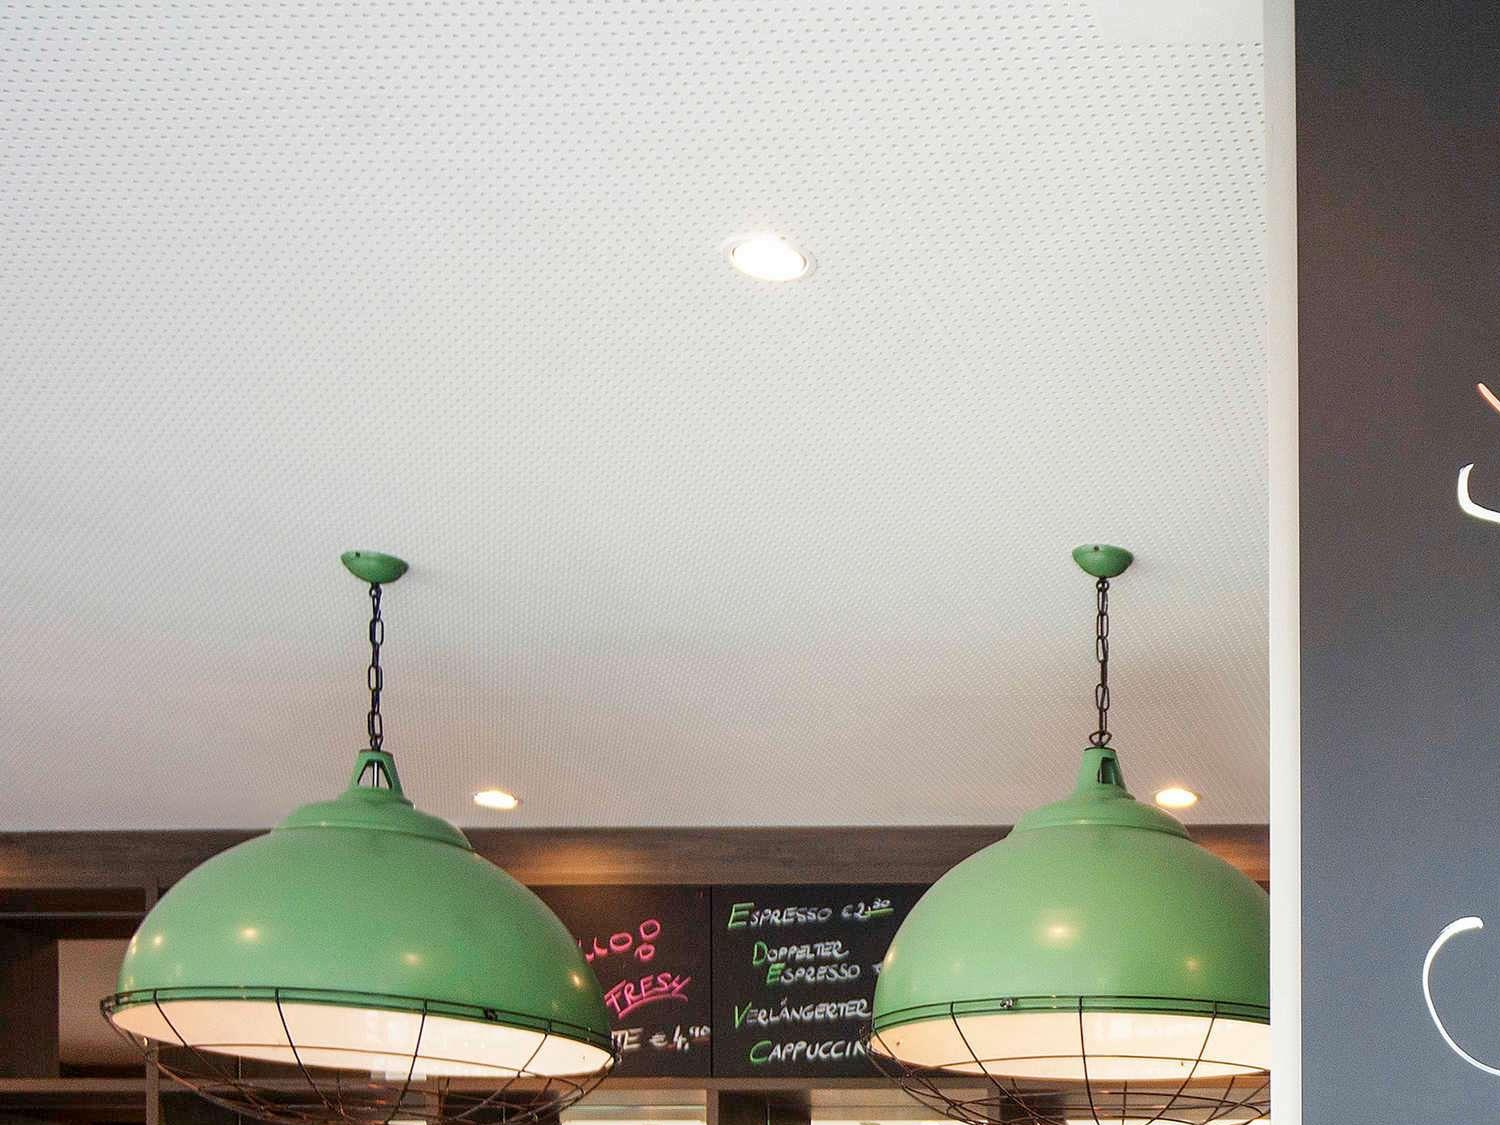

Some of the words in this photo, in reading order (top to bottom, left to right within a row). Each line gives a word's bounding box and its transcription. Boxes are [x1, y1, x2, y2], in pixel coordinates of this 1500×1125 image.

[728, 902, 833, 929] ESPRESSO
[752, 941, 849, 966] DOPPELTER
[766, 962, 861, 984] ESPRESSO
